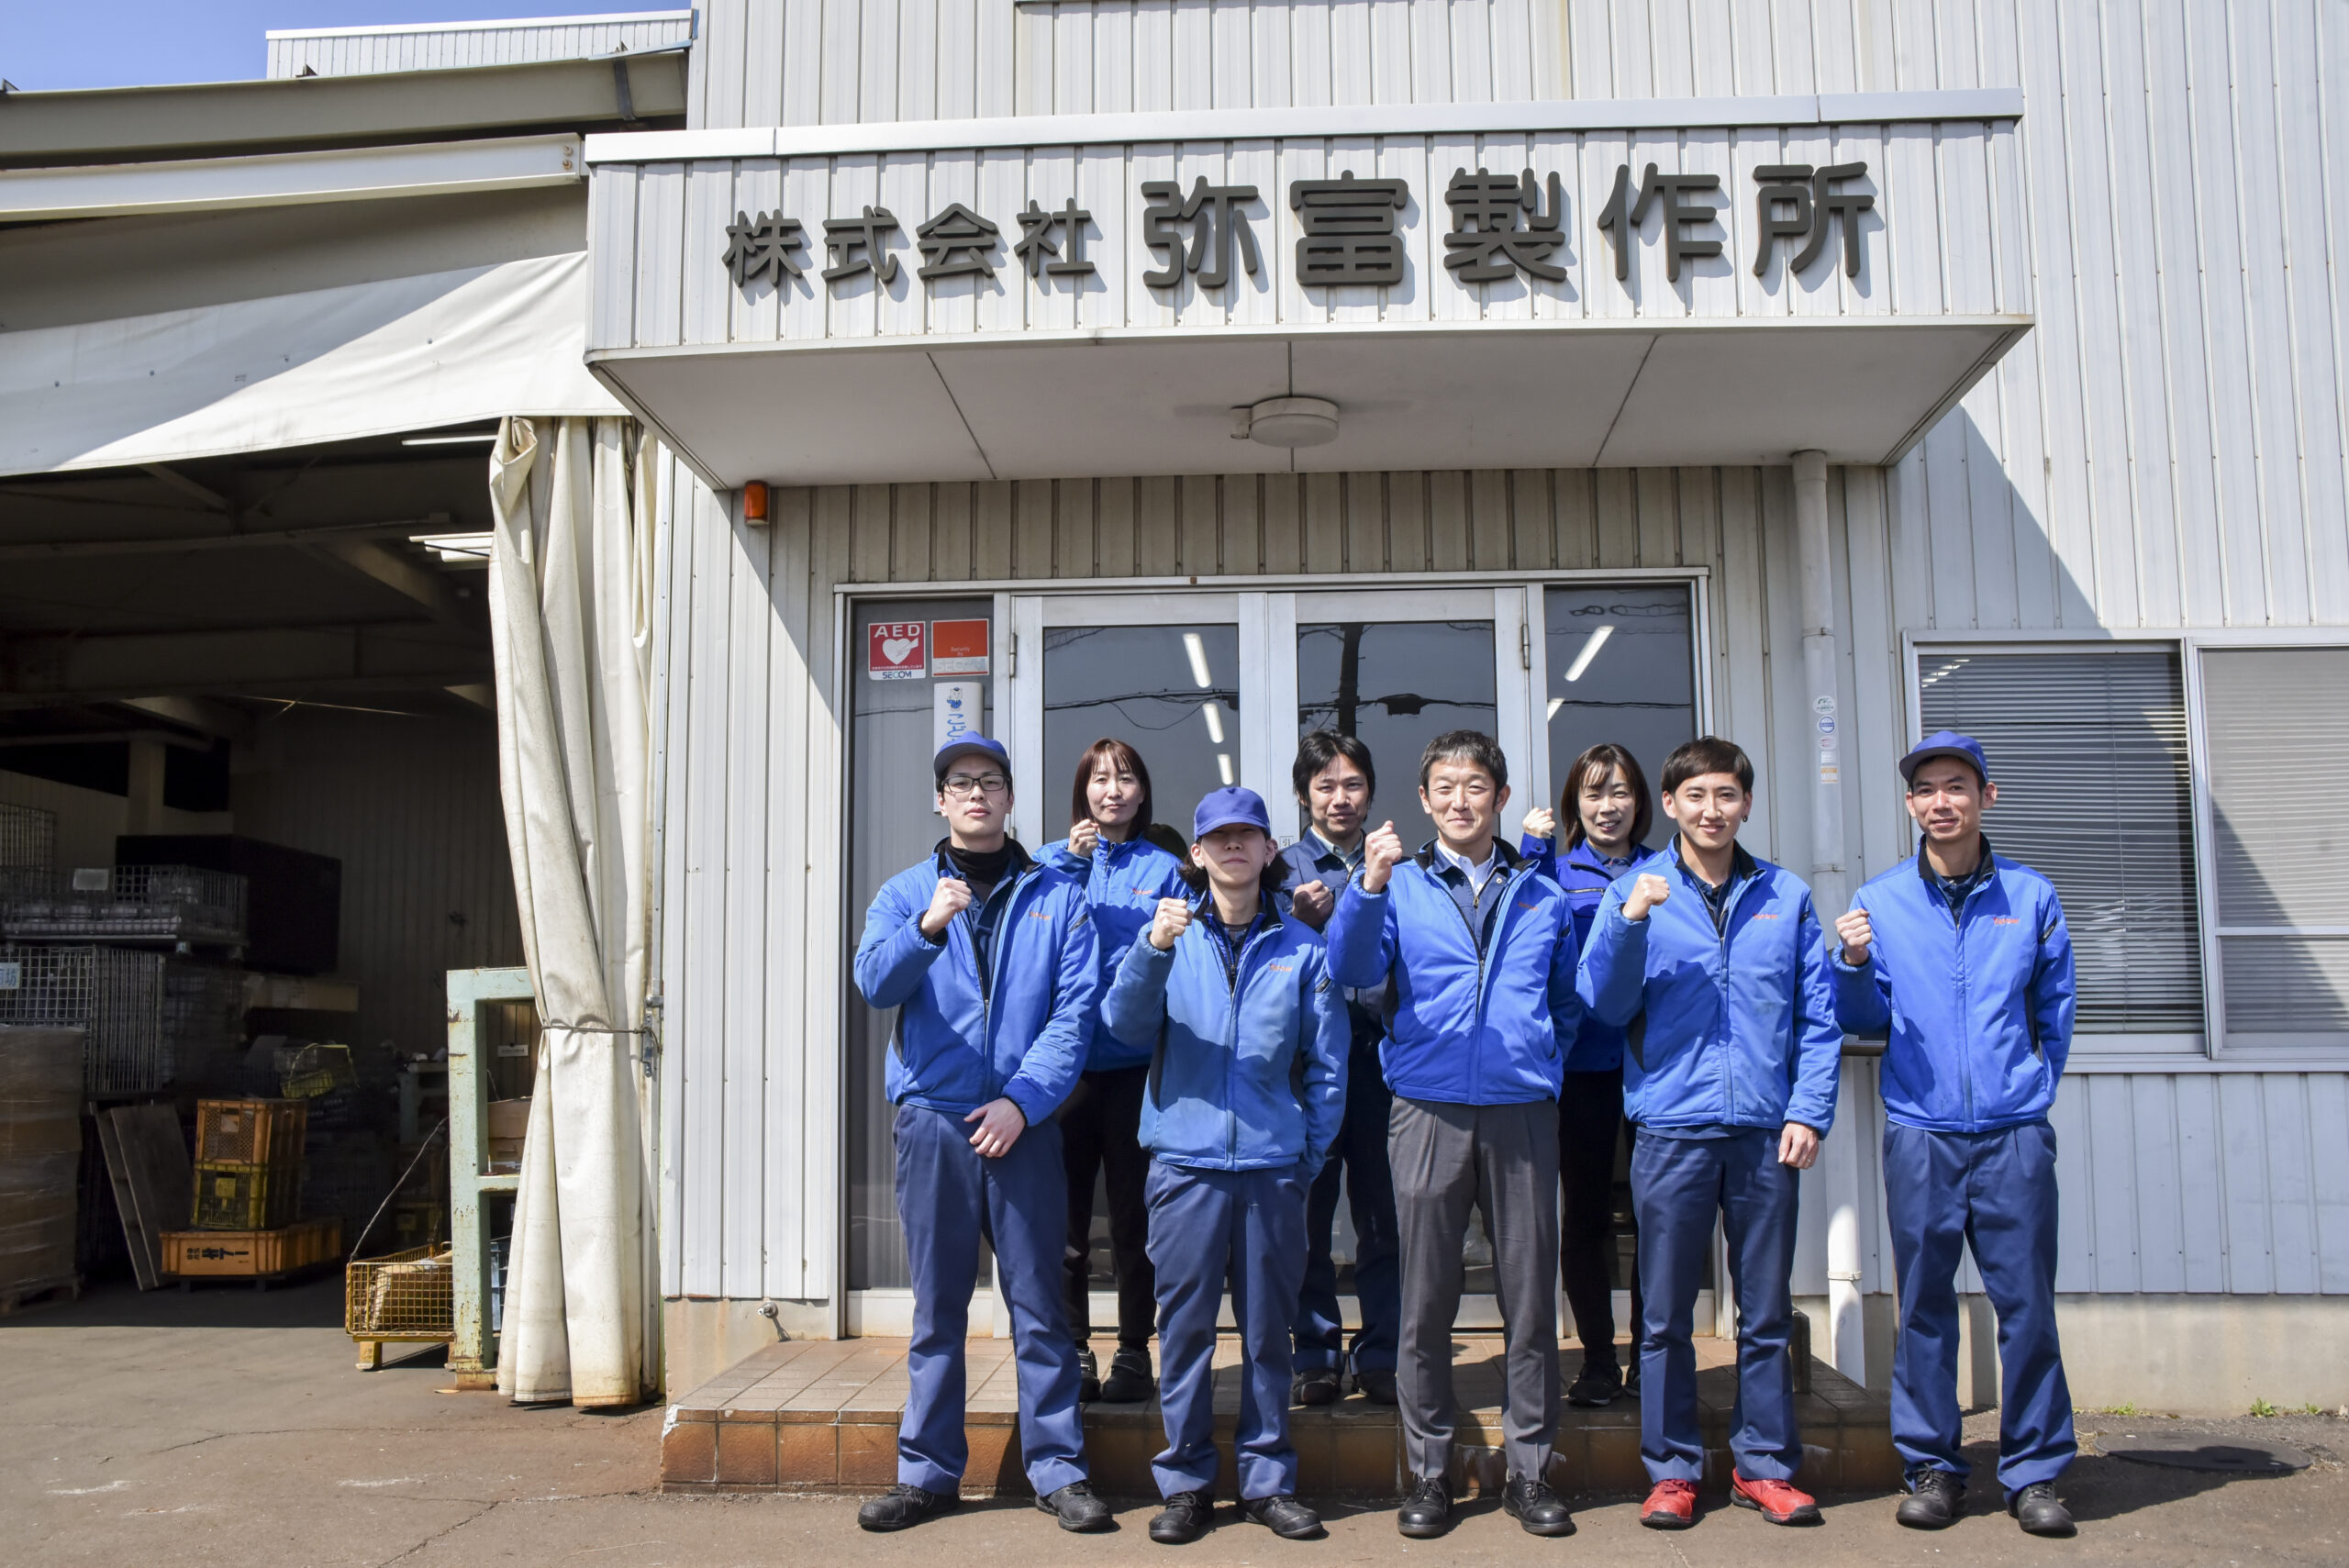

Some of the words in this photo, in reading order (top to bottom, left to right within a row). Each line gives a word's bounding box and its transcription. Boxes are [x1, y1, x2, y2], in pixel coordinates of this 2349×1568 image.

[722, 160, 1876, 289] 株式会社弥富製作所
[874, 624, 920, 638] AED
[883, 671, 912, 679] SECOM
